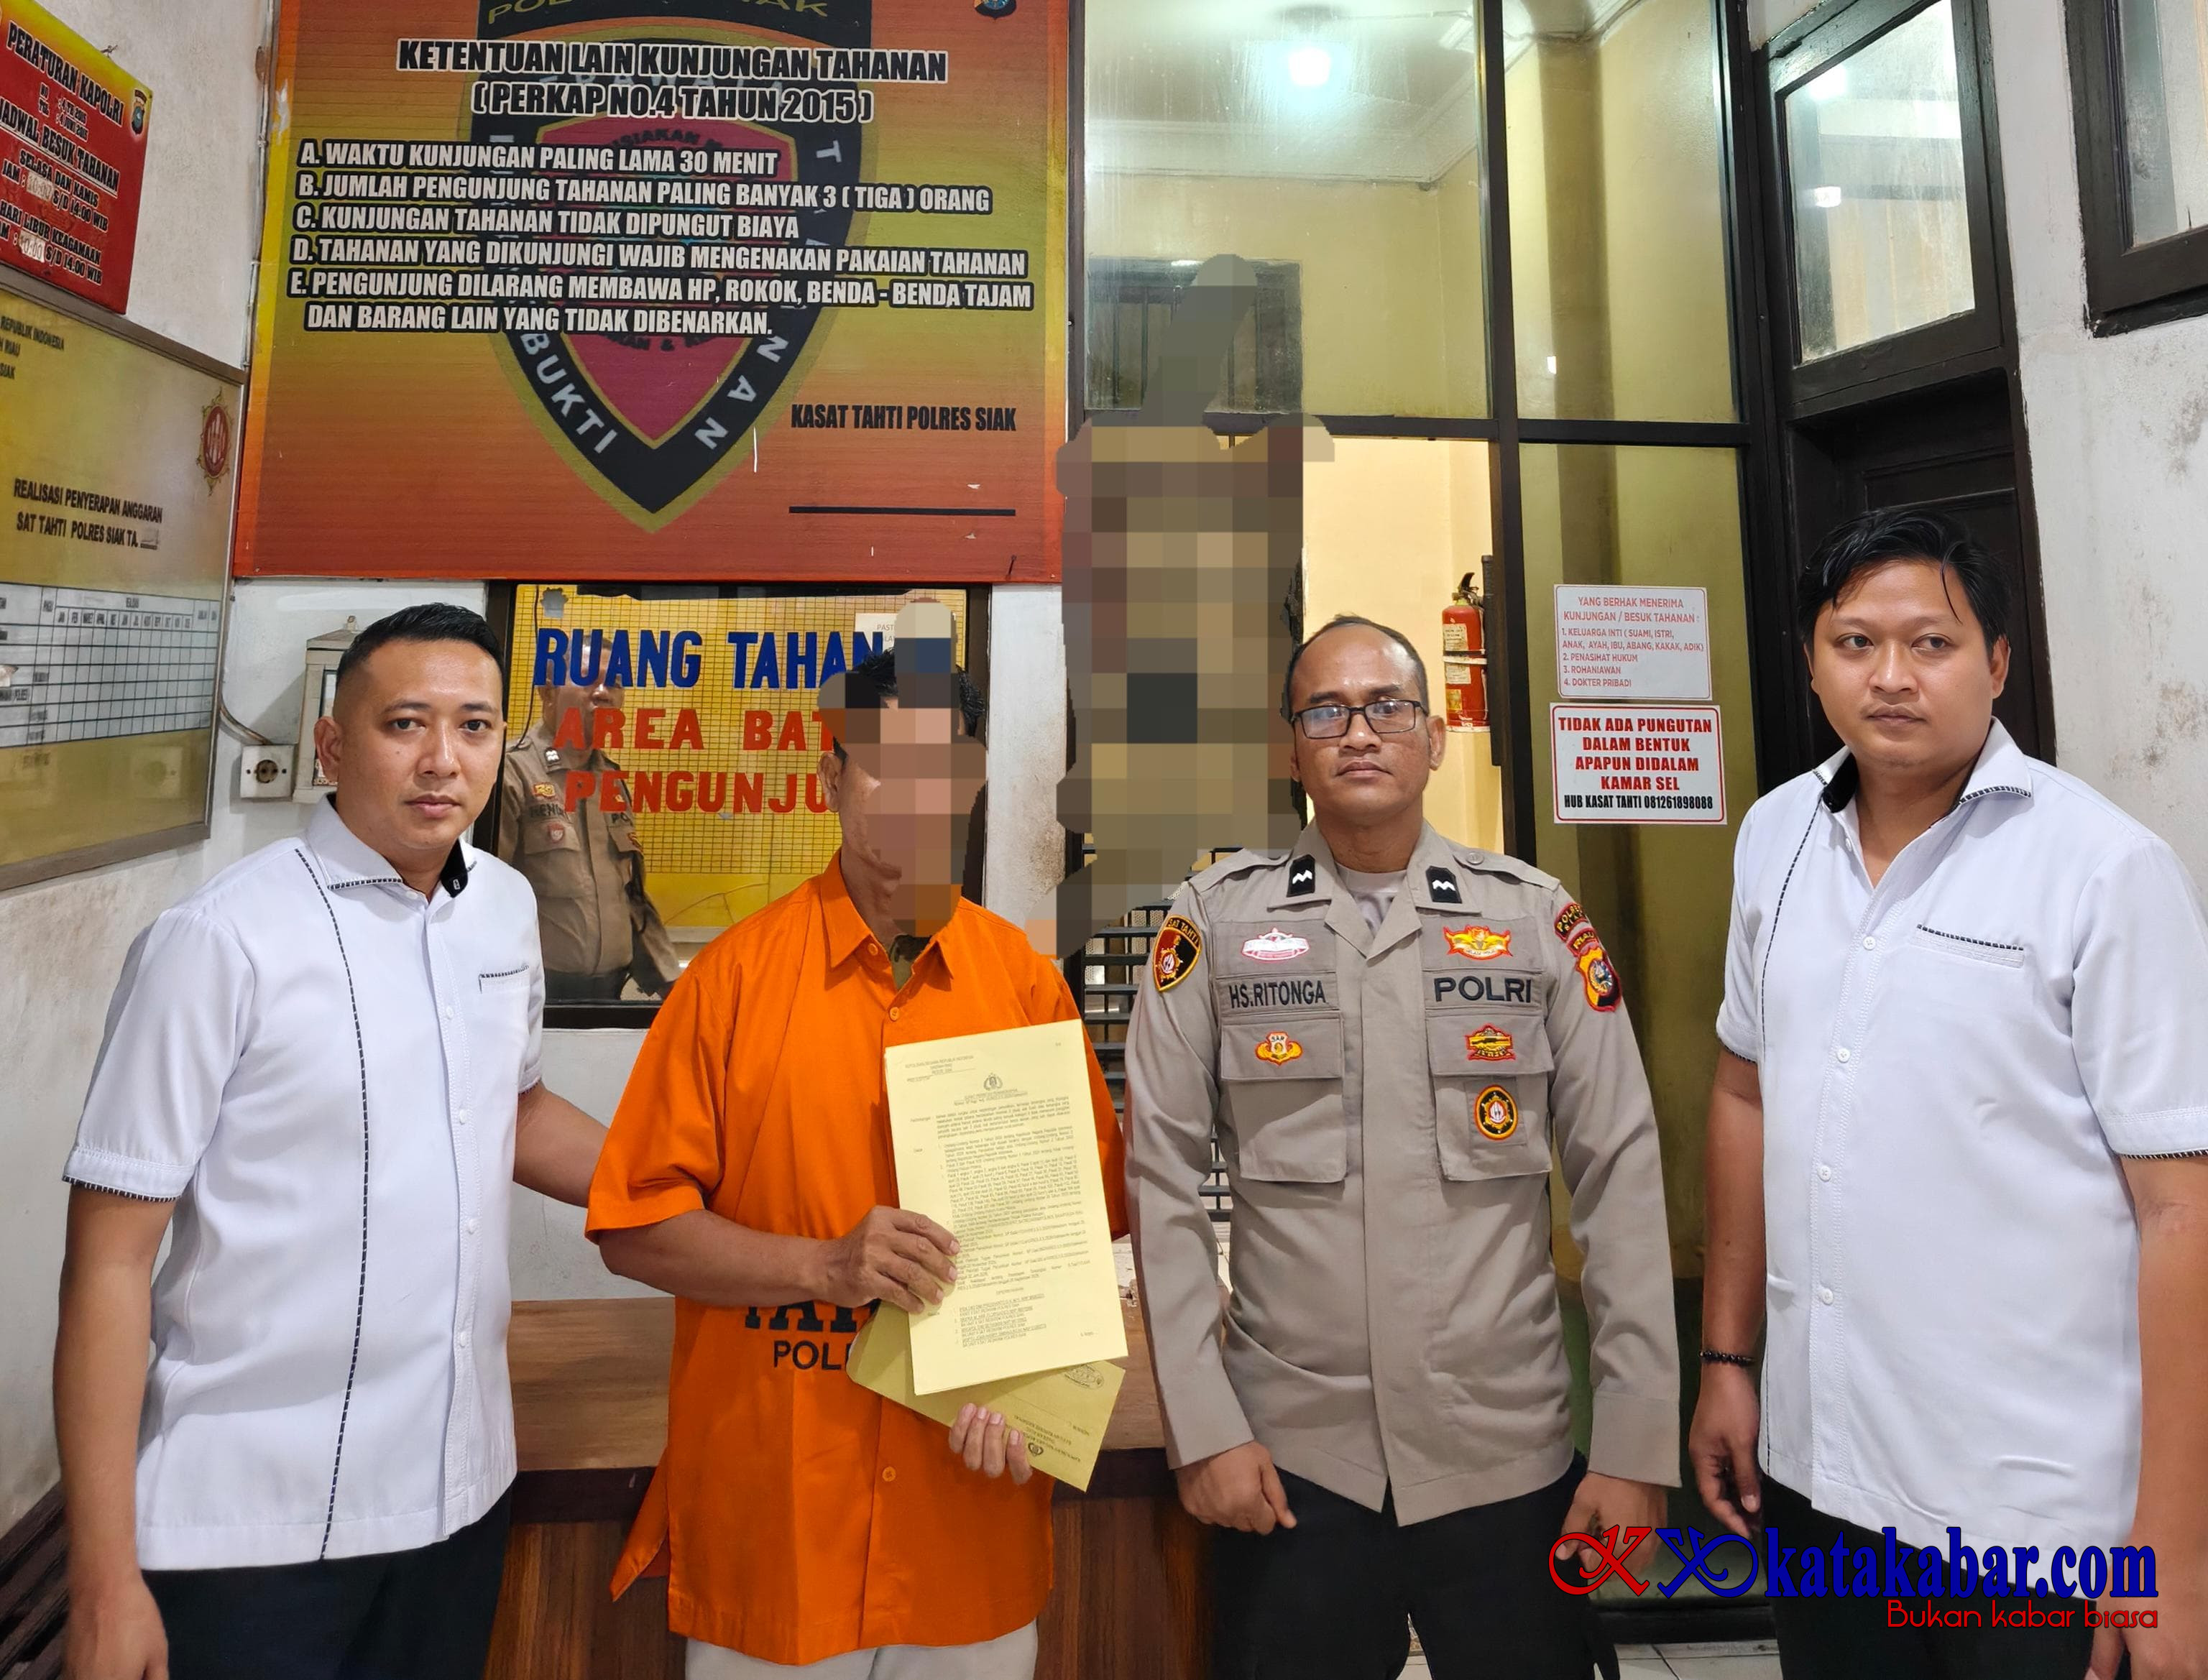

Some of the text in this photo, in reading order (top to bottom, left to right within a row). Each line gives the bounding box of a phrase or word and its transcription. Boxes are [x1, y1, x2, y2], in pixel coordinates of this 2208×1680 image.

[7, 21, 124, 127] PERATURAN KAPOLRI
[398, 40, 564, 72] KETENTUAN
[570, 43, 633, 74] LAIN
[640, 44, 810, 79] KUNJUNGAN
[816, 50, 947, 82] TAHANAN
[491, 83, 604, 115] PERKAP
[608, 86, 676, 117] NO.4
[680, 88, 778, 119] TAHUN
[782, 90, 855, 121] 2015
[42, 124, 75, 167] BESUK
[77, 146, 120, 193] TAHANAN
[300, 142, 778, 175] A. WAKTU KUNJUNGAN PALING LAMA 30 MENIT
[2, 158, 109, 233] JAM S/D WIB
[19, 149, 100, 209] SELASA DAN KAMIS
[298, 174, 319, 196] B.
[323, 175, 408, 198] JUMLAH
[412, 176, 550, 201] PENGUNJUNG
[555, 179, 652, 203] TAHANAN
[657, 181, 730, 206] PALING
[735, 183, 819, 208] BANYAK
[822, 185, 837, 208] 3
[919, 188, 990, 212] ORANG
[0, 199, 102, 267] HARI LIBUR KEAGAMAAN
[296, 205, 799, 239] C. KUNJUNGAN TAHANAN TIDAK DIPUNGUT BIAYA
[45, 244, 63, 267] S/D
[87, 264, 103, 286] WIB
[293, 238, 1025, 276] D. TAHANAN YANG DIKUNJUNGI WAJIB MENGENAKAN PAKAIAN TAHANAN
[290, 271, 307, 294] E.
[312, 272, 453, 297] PENGUNJUNG
[457, 273, 564, 299] DILARANG
[568, 275, 683, 301] MEMBAWA
[687, 278, 720, 303] HP,
[724, 279, 802, 305] ROKOK,
[806, 280, 875, 305] BENDA
[891, 282, 961, 308] BENDA
[964, 284, 1031, 308] TAJAM
[307, 304, 773, 335] DAN BARANG LAIN YANG TIDAK DIBENARKAN.
[791, 404, 1017, 432] KASAT TAHTI POLRES SIAK
[14, 478, 164, 523] REALISASI PENYERAPAN ANGGARAN
[17, 512, 37, 532] SAT
[38, 514, 67, 537] TAHTI
[70, 520, 105, 543] POLRES
[106, 526, 125, 546] SIAK
[1563, 611, 1616, 622] KUNJUNGAN
[1624, 611, 1652, 622] BESUK
[1654, 613, 1695, 623] TAHANAN
[1578, 596, 1684, 608] YANG BERHAK MENERIMA
[1562, 628, 1567, 637] 1.
[1568, 628, 1607, 637] KELUARGA
[1608, 629, 1622, 637] INTI
[1562, 640, 1585, 650] ANAK,
[1588, 641, 1610, 650] AYAH,
[1626, 642, 1654, 651] ABANG,
[1655, 643, 1683, 652] KAKAK,
[533, 627, 704, 689] RUANG
[1570, 653, 1611, 662] PENASIHAT
[1611, 654, 1638, 663] HUKUM
[1570, 665, 1622, 674] ROHANIAWAN
[1564, 678, 1632, 688] 4. DOKTER PRIBADI
[552, 707, 705, 751] AREA
[1558, 717, 1712, 733] TIDAK ADA PUNGUTAN
[1582, 737, 1690, 752] DALAM BENTUK
[1575, 756, 1699, 771] APAPUN DIDALAM
[1600, 776, 1680, 790] KAMAR SEL
[1564, 795, 1714, 810] HUB KASAT TAHTI 081261898088
[1228, 979, 1327, 1009] HS.RITONGA
[1433, 974, 1532, 1005] POLRI
